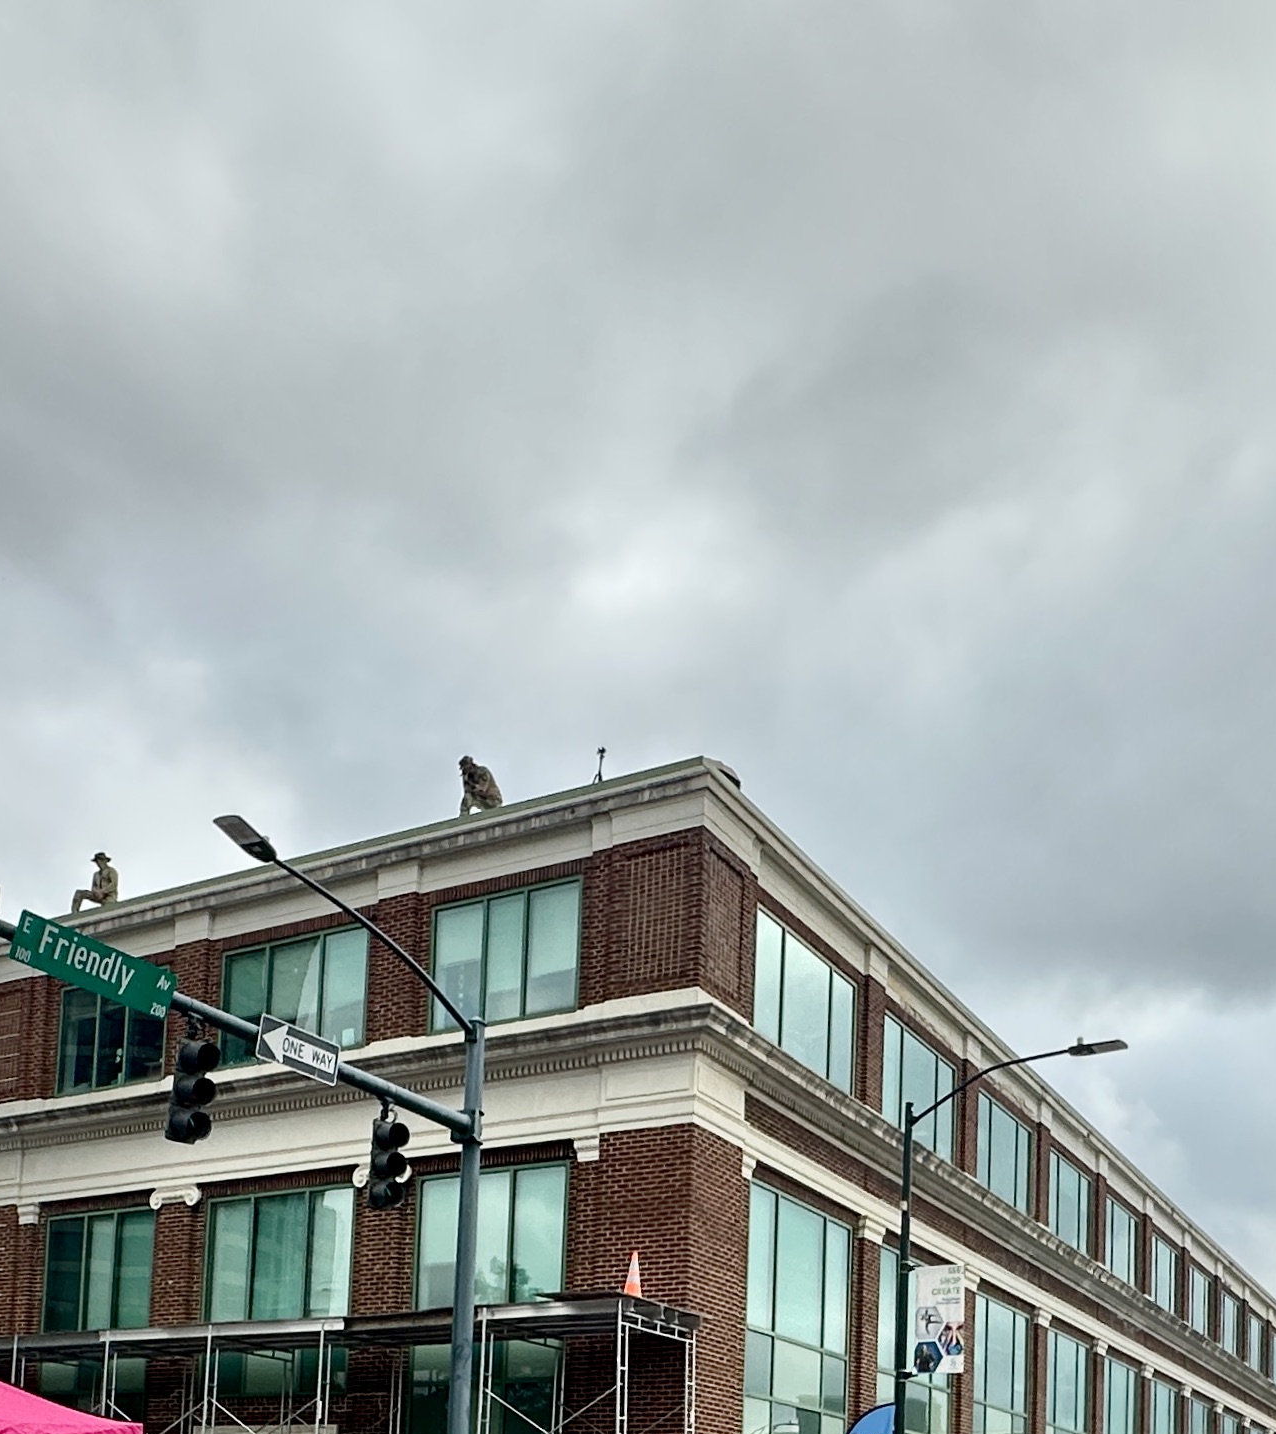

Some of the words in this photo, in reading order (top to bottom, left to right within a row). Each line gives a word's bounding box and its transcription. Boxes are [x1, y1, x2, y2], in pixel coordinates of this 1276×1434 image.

[14, 945, 32, 963] 100
[150, 1002, 167, 1018] 200
[22, 917, 33, 934] E
[38, 924, 135, 995] Friendly
[156, 974, 172, 991] Av
[282, 1036, 304, 1060] ONE
[311, 1050, 335, 1073] WAY
